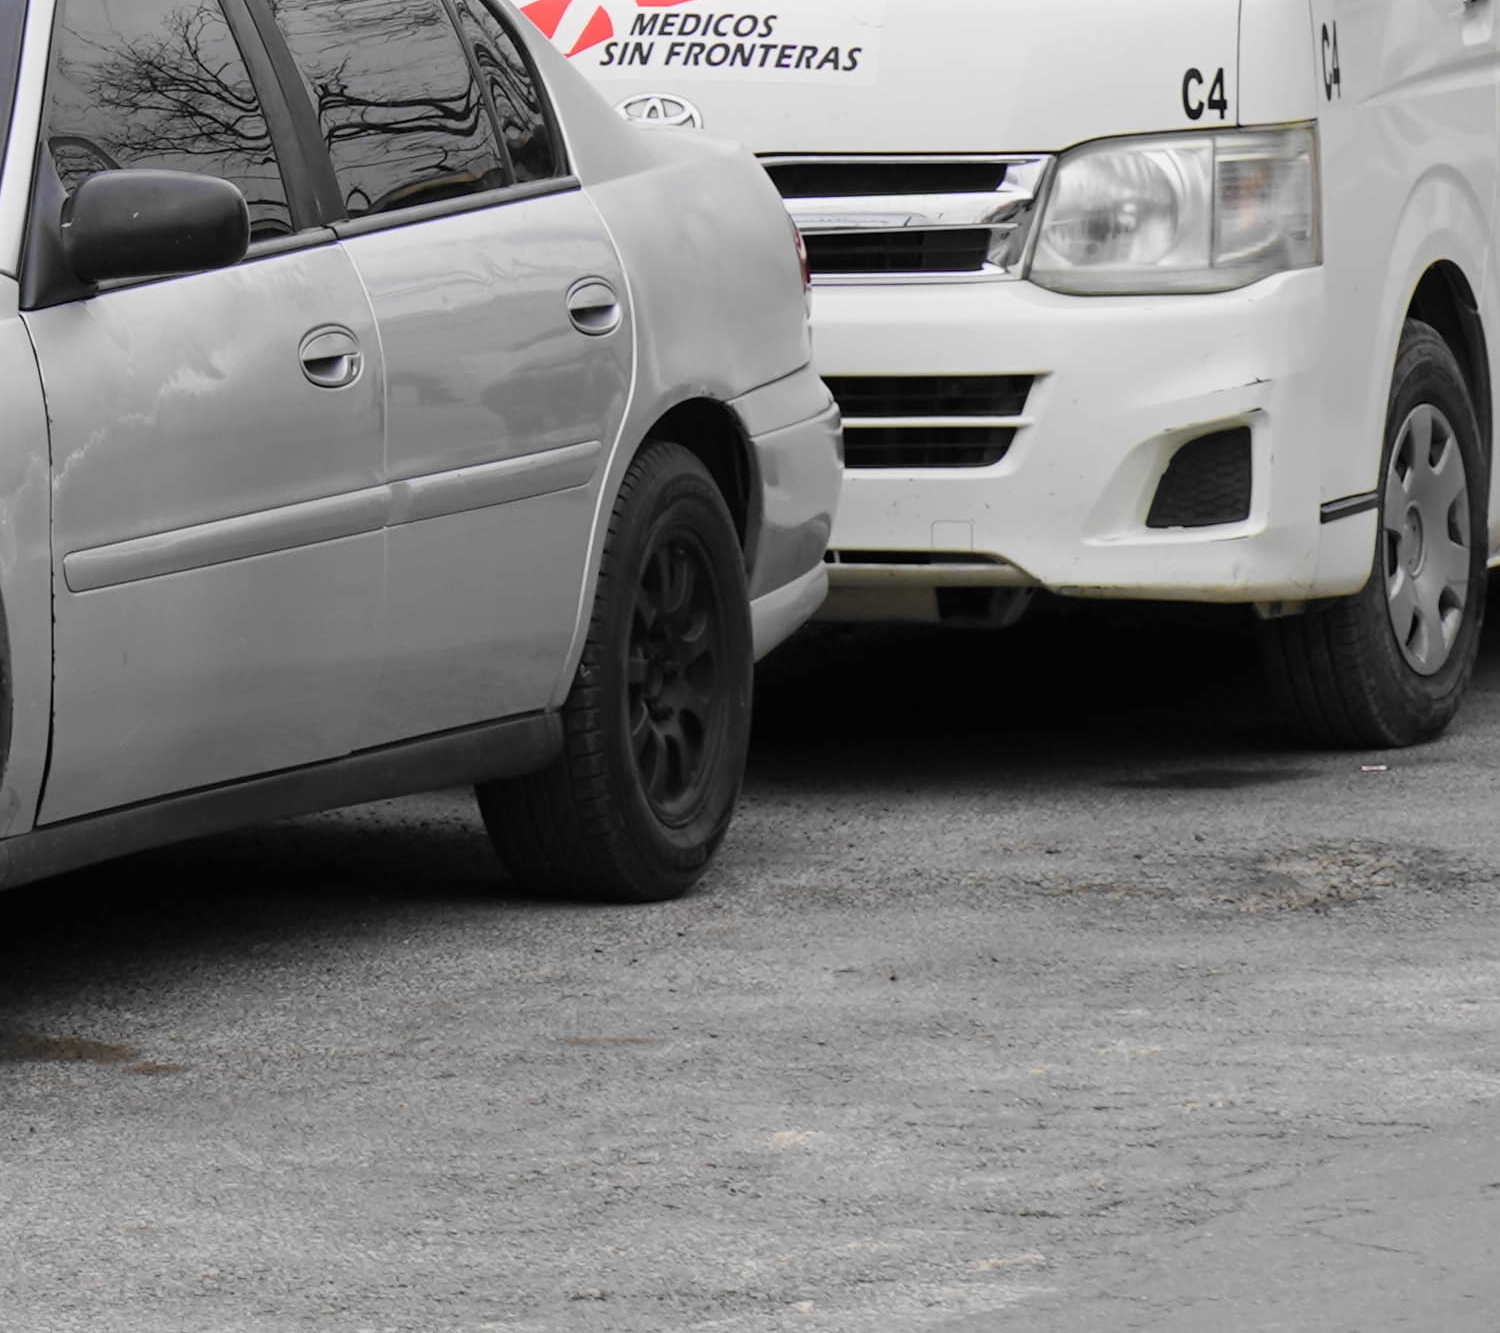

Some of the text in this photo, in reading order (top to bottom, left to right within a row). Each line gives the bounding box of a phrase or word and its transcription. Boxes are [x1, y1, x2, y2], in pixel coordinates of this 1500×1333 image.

[630, 13, 778, 38] MEDICOS
[599, 41, 862, 72] SIN FRONTERAS
[1321, 20, 1341, 102] C4
[1182, 67, 1228, 120] C4
